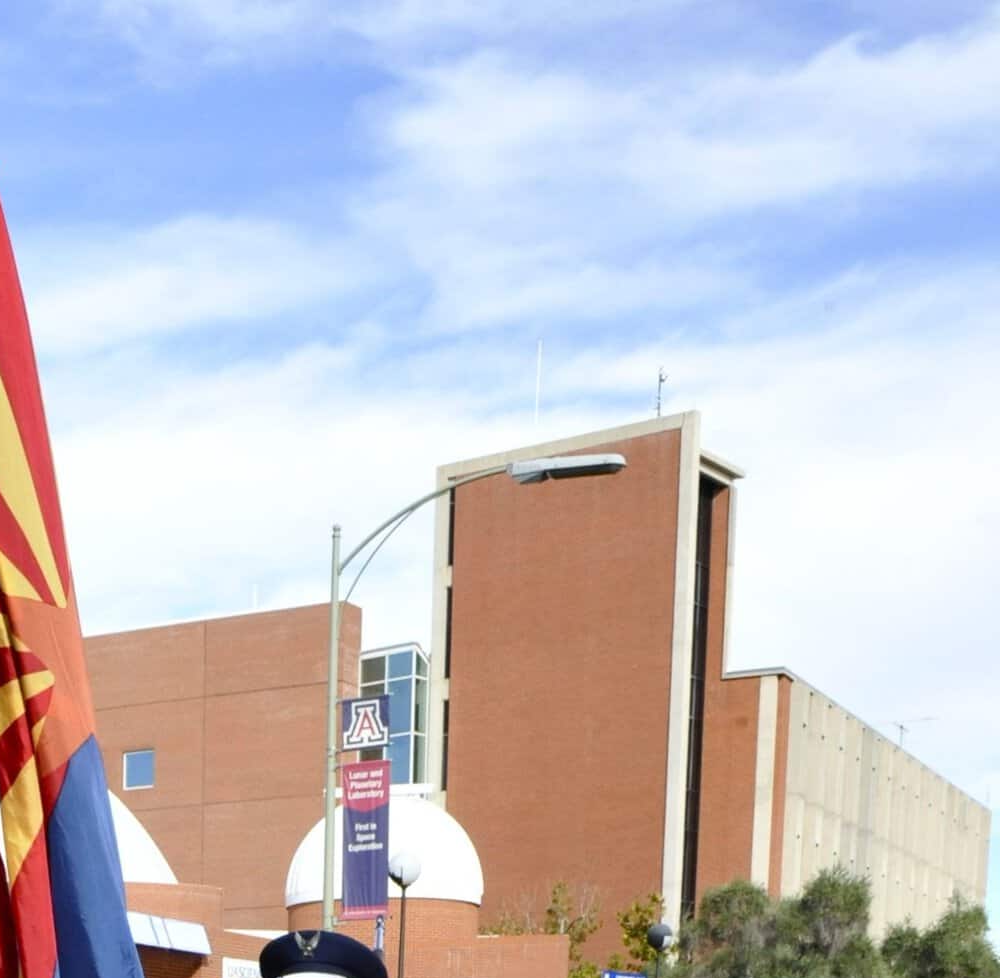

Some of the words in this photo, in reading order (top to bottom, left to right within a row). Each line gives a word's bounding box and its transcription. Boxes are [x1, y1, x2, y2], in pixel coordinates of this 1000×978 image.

[350, 780, 382, 790] Planetary
[347, 790, 384, 800] Laboratory
[355, 823, 369, 832] First
[356, 833, 376, 842] Space
[348, 842, 383, 852] Exploration
